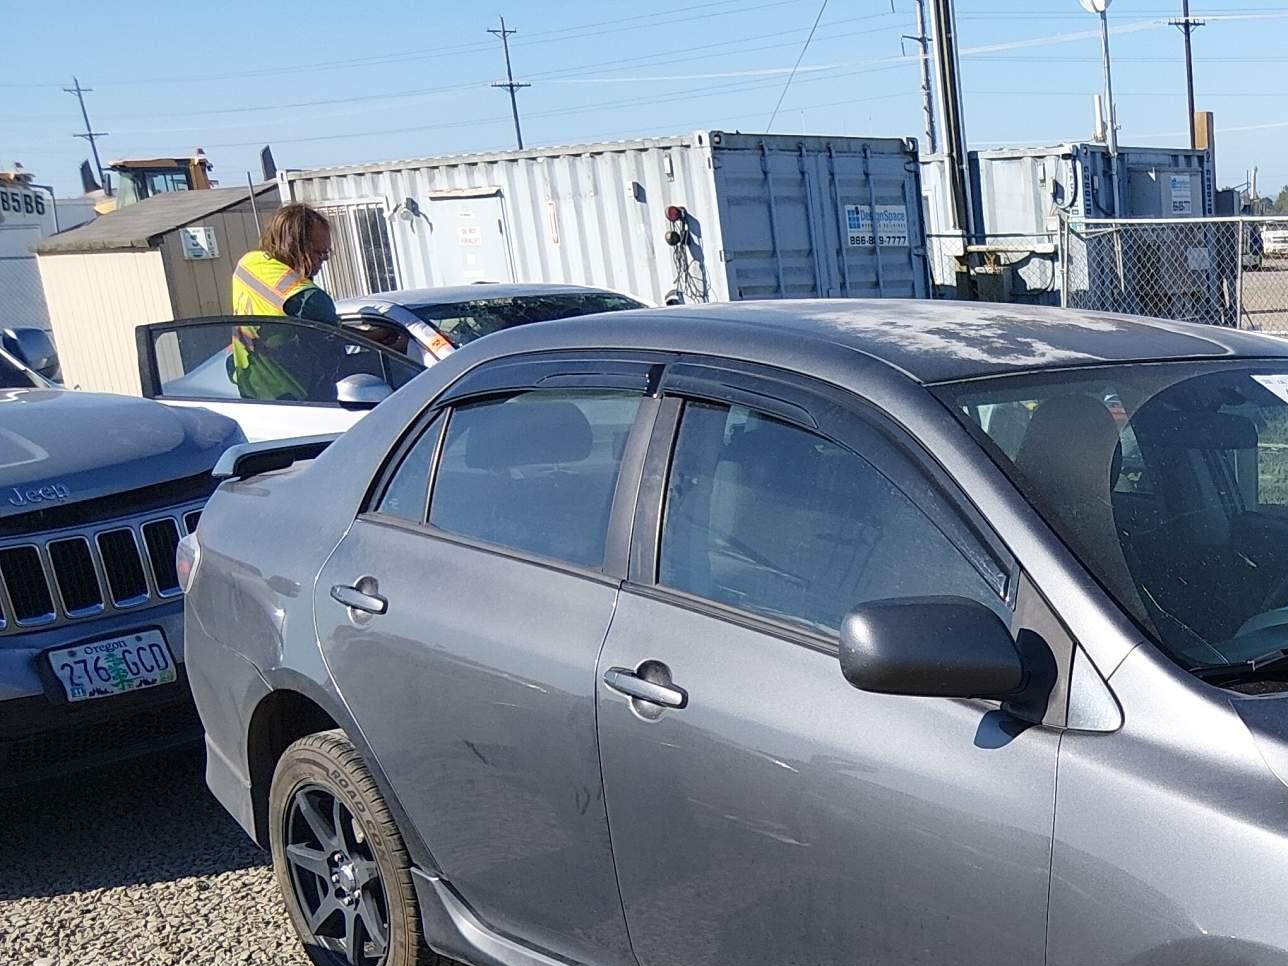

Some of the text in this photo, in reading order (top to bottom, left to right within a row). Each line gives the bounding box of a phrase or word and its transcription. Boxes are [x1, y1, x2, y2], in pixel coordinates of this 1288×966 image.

[8, 484, 71, 506] Jeep
[84, 640, 127, 655] Oregon
[61, 643, 168, 687] 276 GCD
[331, 769, 366, 813] ROAD
